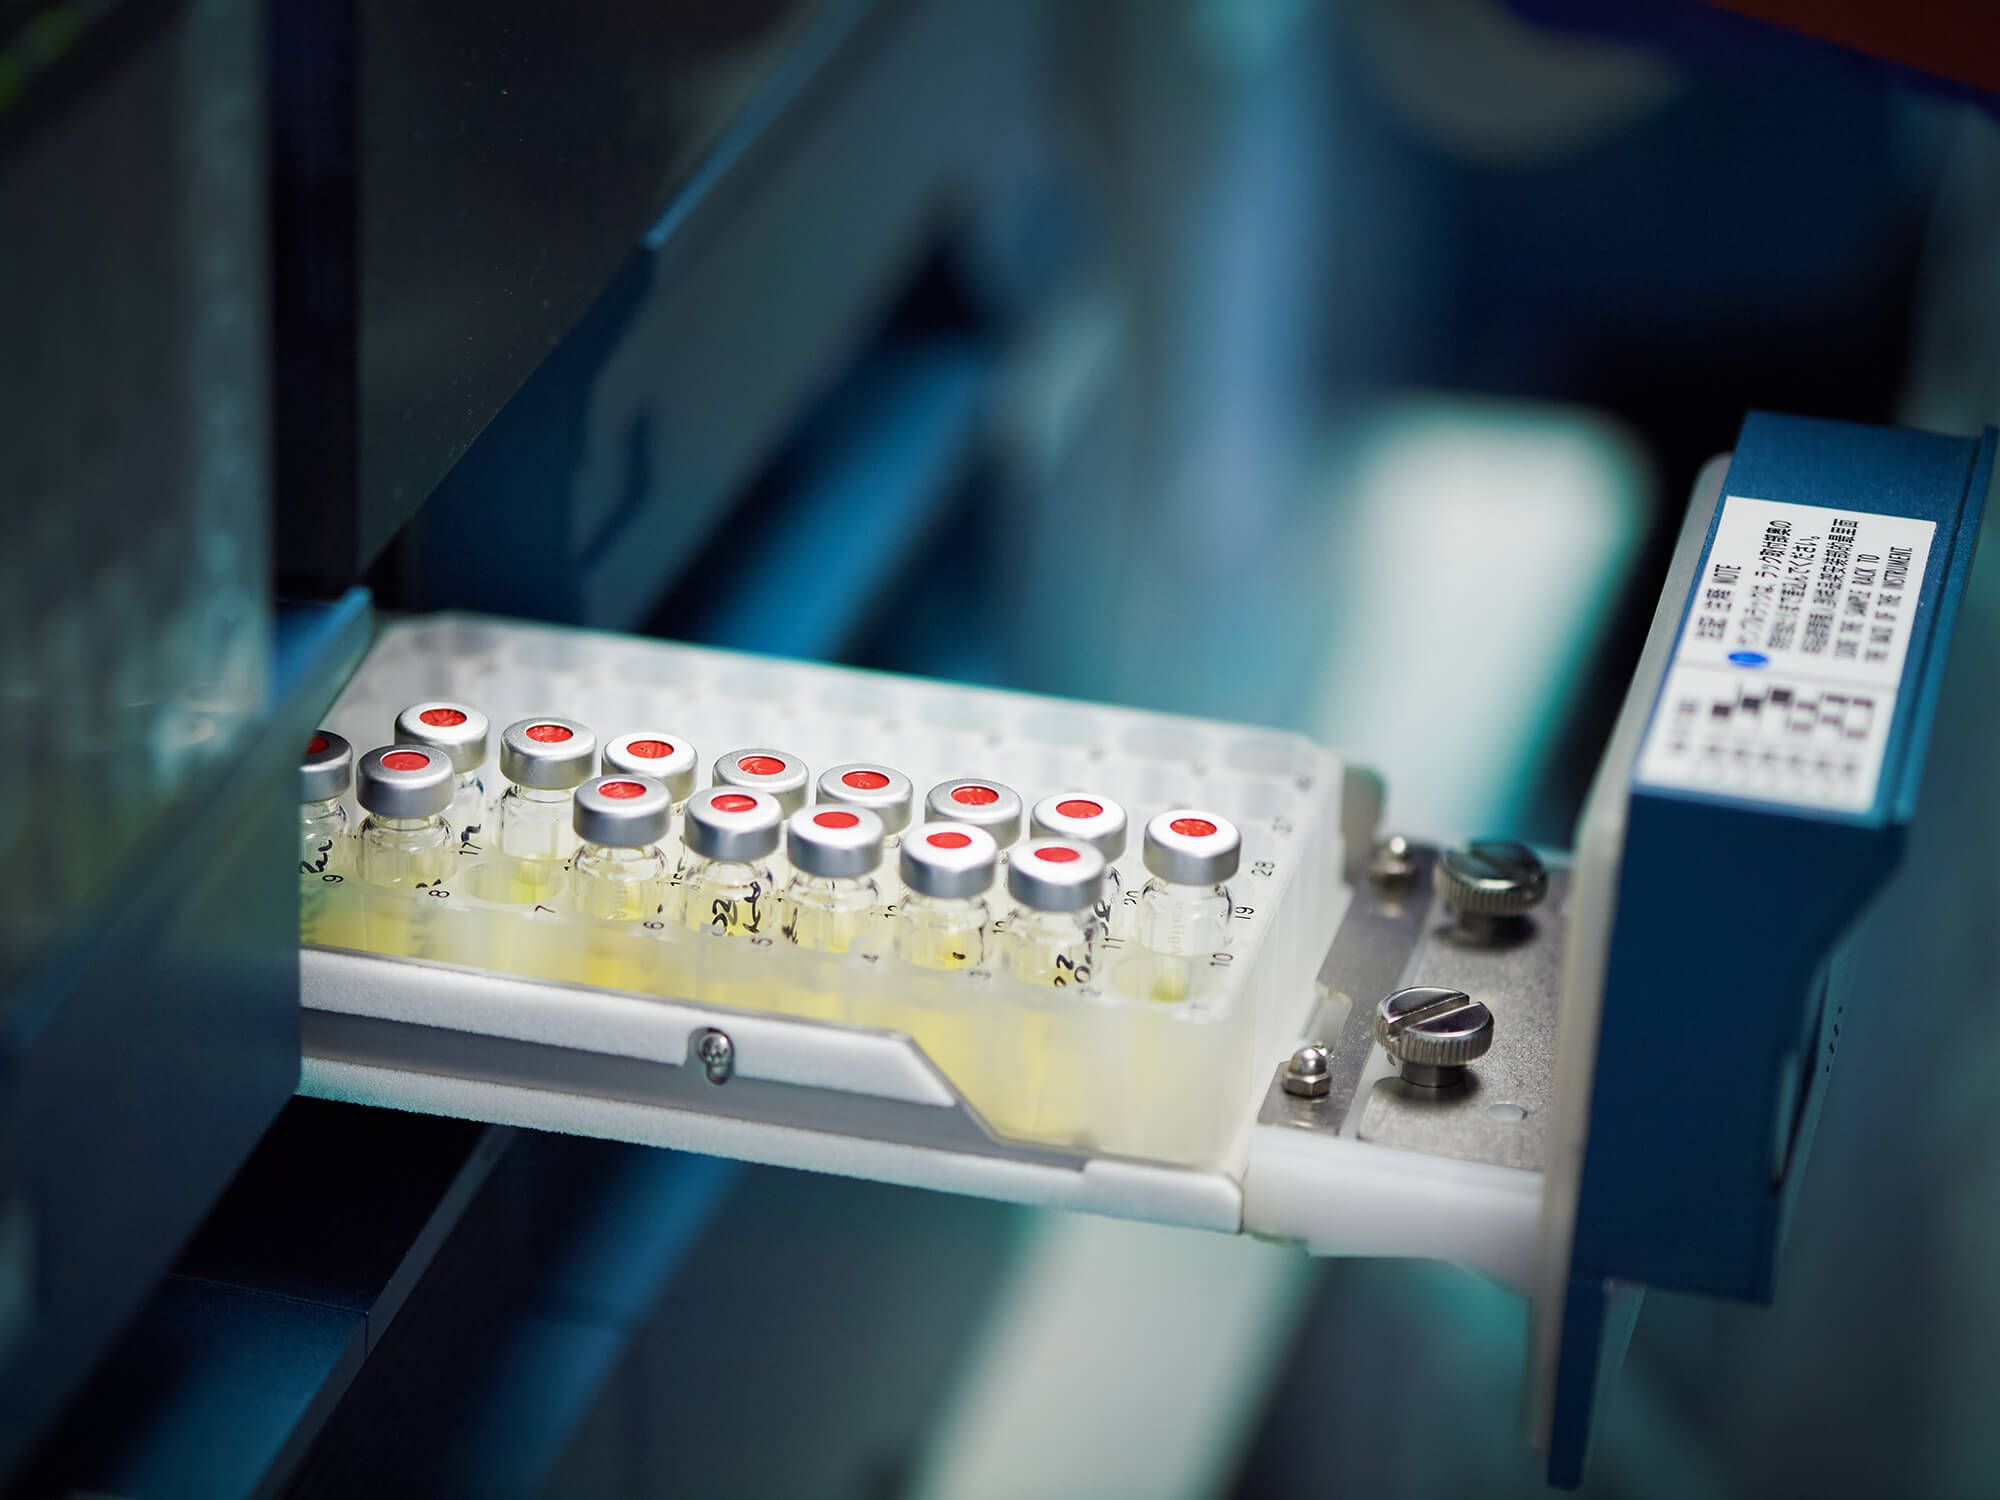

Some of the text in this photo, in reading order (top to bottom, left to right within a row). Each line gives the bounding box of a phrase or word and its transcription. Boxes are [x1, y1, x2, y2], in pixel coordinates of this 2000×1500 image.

[1857, 553, 1880, 564] TO
[1712, 563, 1741, 585] NOTE
[1851, 566, 1876, 586] RACK
[458, 842, 482, 856] 17
[1251, 861, 1276, 878] 28
[322, 873, 344, 884] 9
[428, 889, 450, 899] 8
[534, 904, 556, 914] 7
[1234, 905, 1255, 920] 19
[643, 920, 665, 931] 6
[1101, 936, 1125, 949] 11
[1209, 952, 1234, 967] 10
